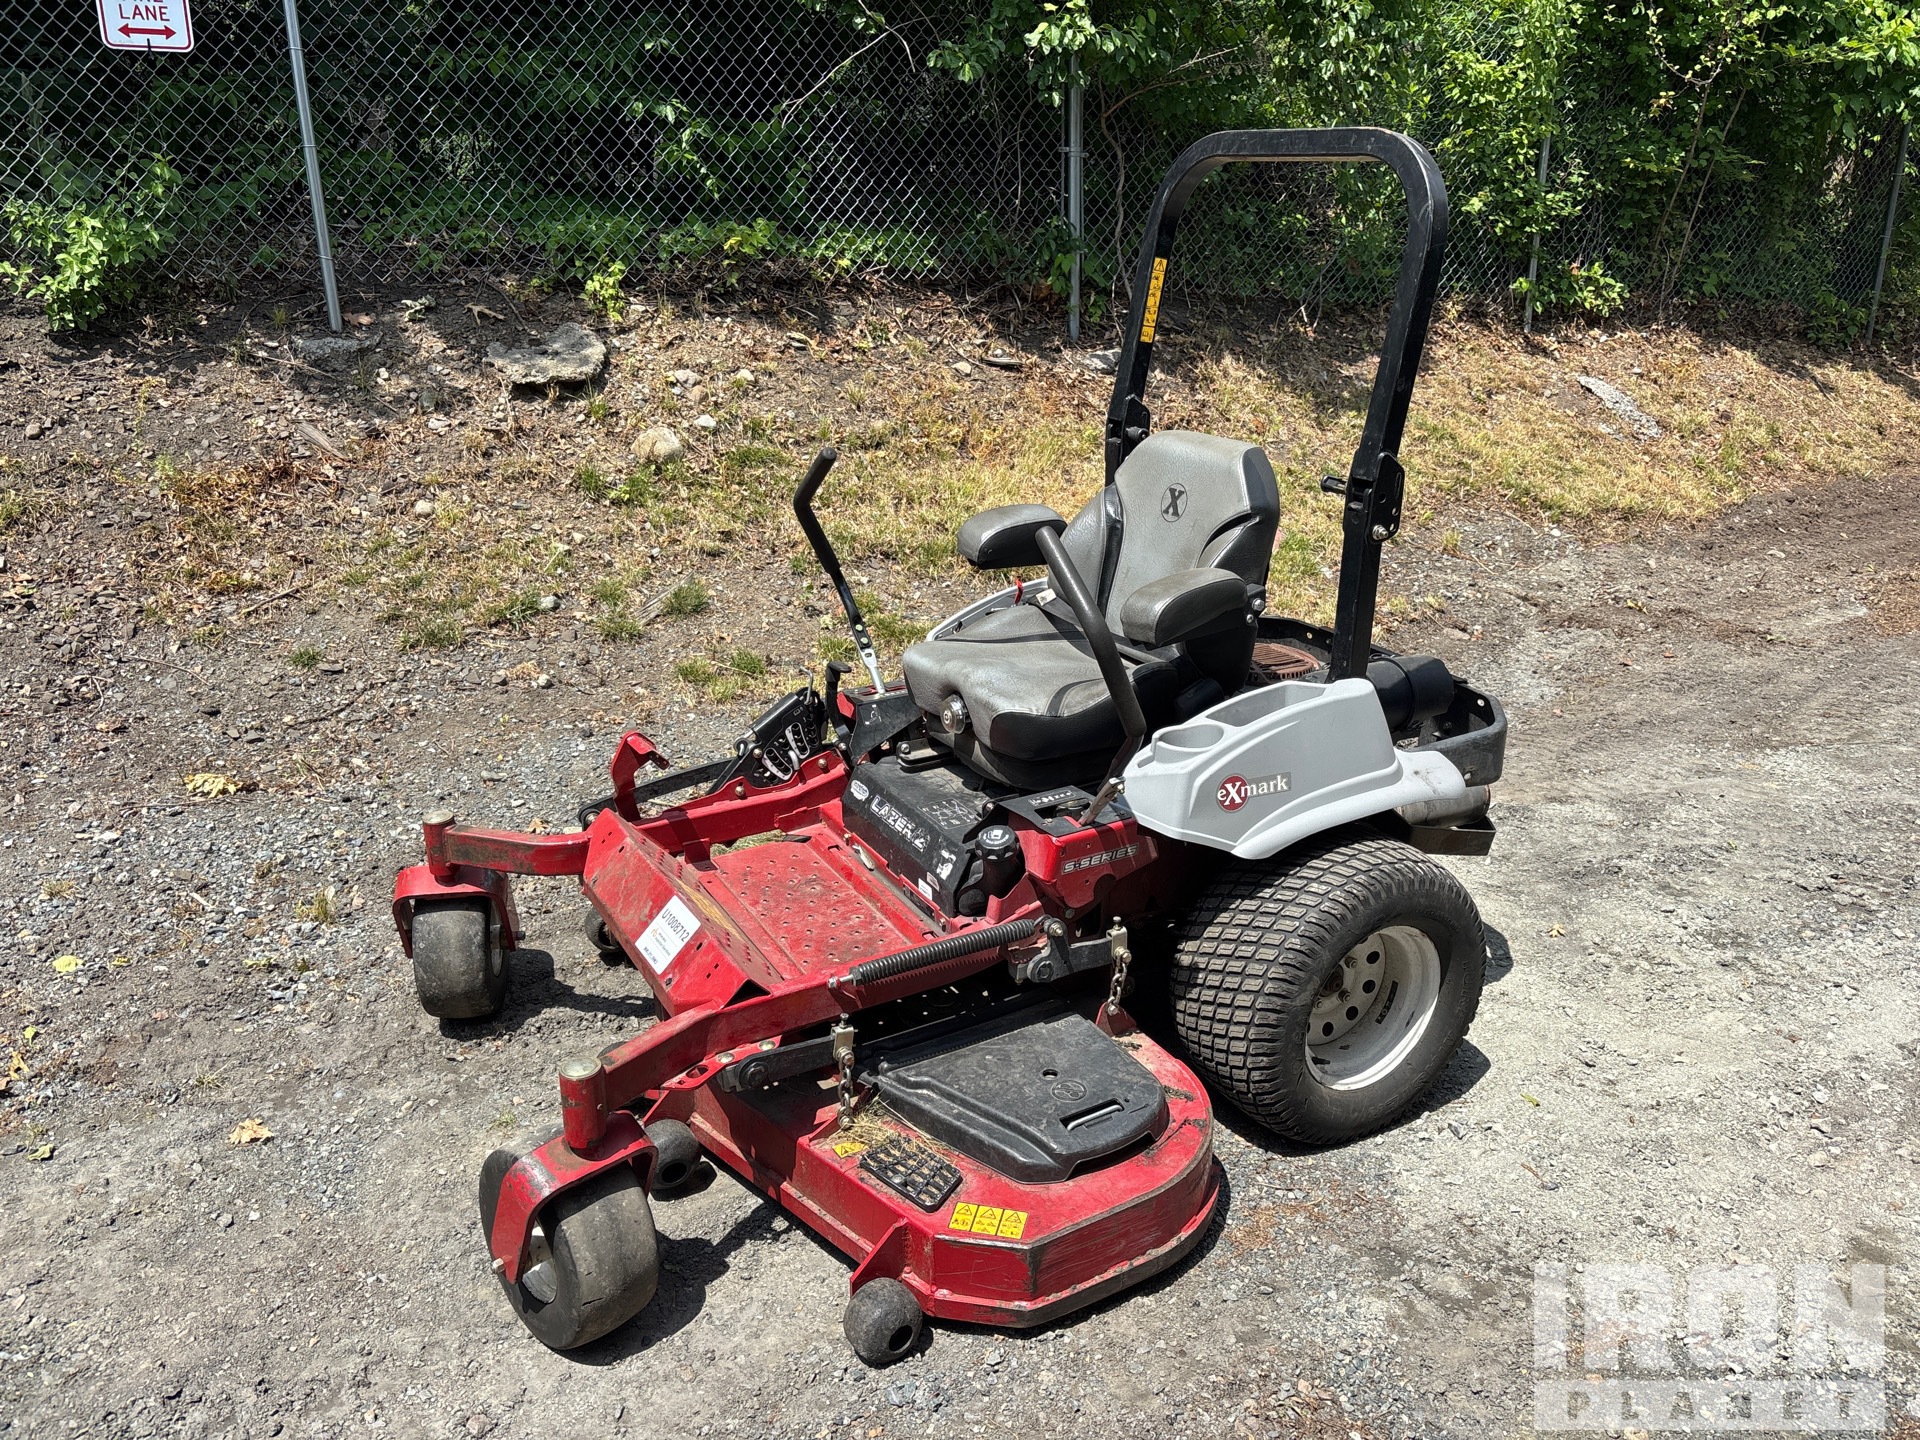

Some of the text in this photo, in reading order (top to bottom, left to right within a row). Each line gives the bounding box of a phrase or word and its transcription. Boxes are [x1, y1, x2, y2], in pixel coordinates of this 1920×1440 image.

[118, 3, 170, 22] LANE
[870, 794, 916, 843] LAZER
[661, 908, 690, 943] U1008712
